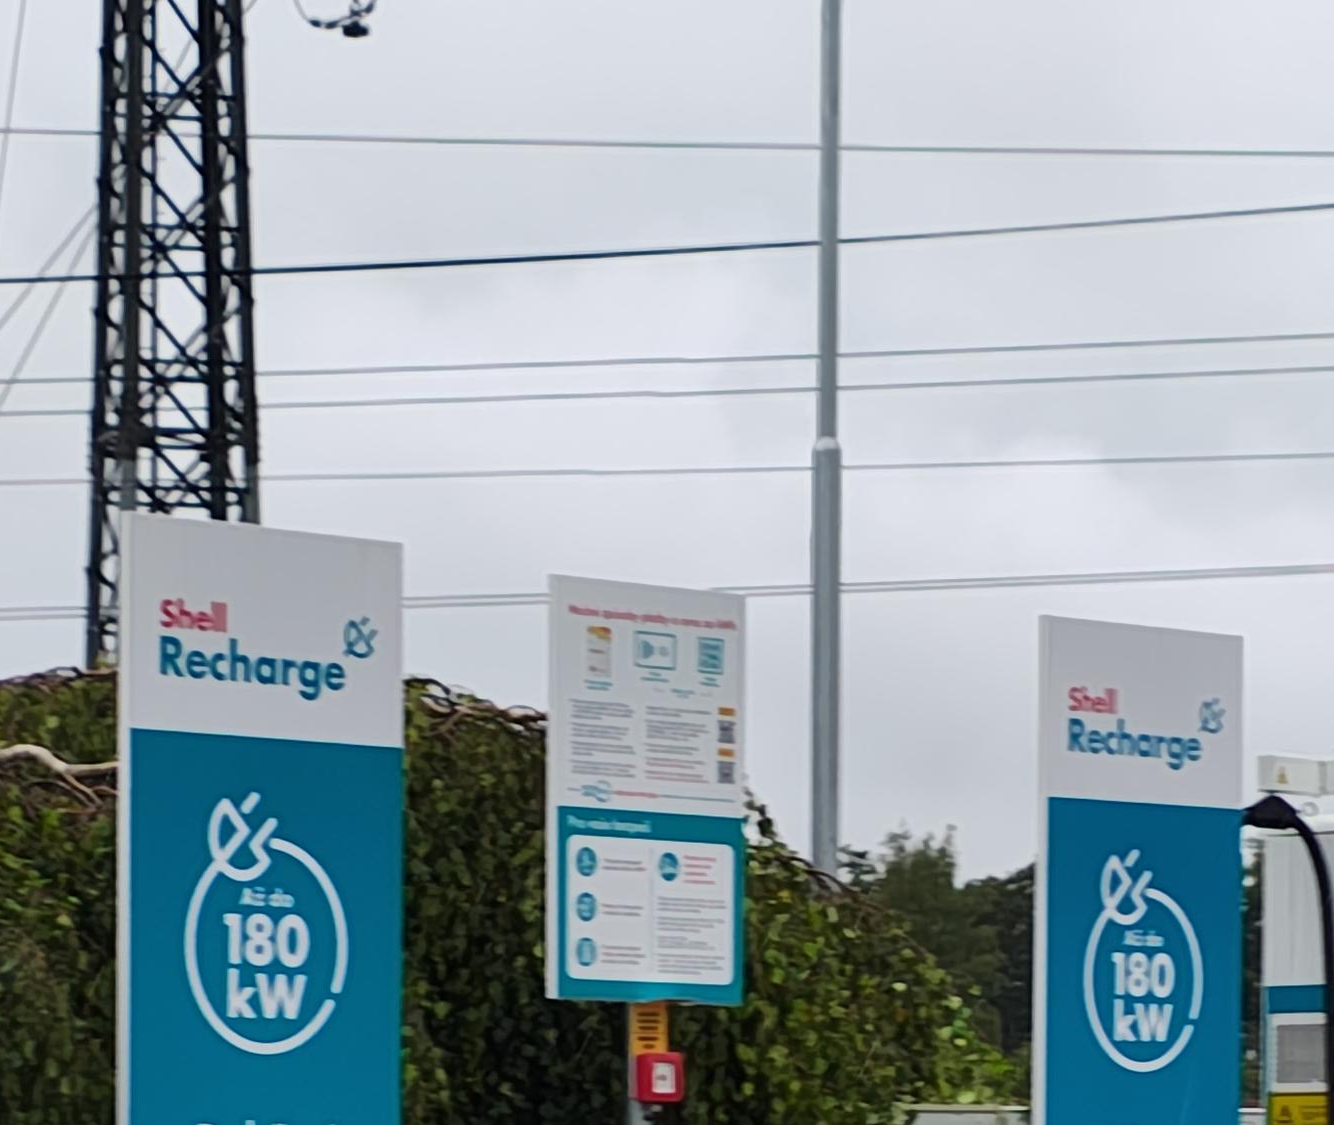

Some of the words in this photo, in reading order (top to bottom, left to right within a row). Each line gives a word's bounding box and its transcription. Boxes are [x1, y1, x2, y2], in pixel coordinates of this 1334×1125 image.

[160, 598, 227, 632] Shell
[159, 635, 346, 700] Recharge
[1068, 686, 1118, 714] Shell
[1067, 718, 1202, 770] Recharge
[223, 913, 311, 967] 180
[226, 968, 308, 1020] kW
[1111, 952, 1176, 998] 180
[1113, 999, 1174, 1042] kW
